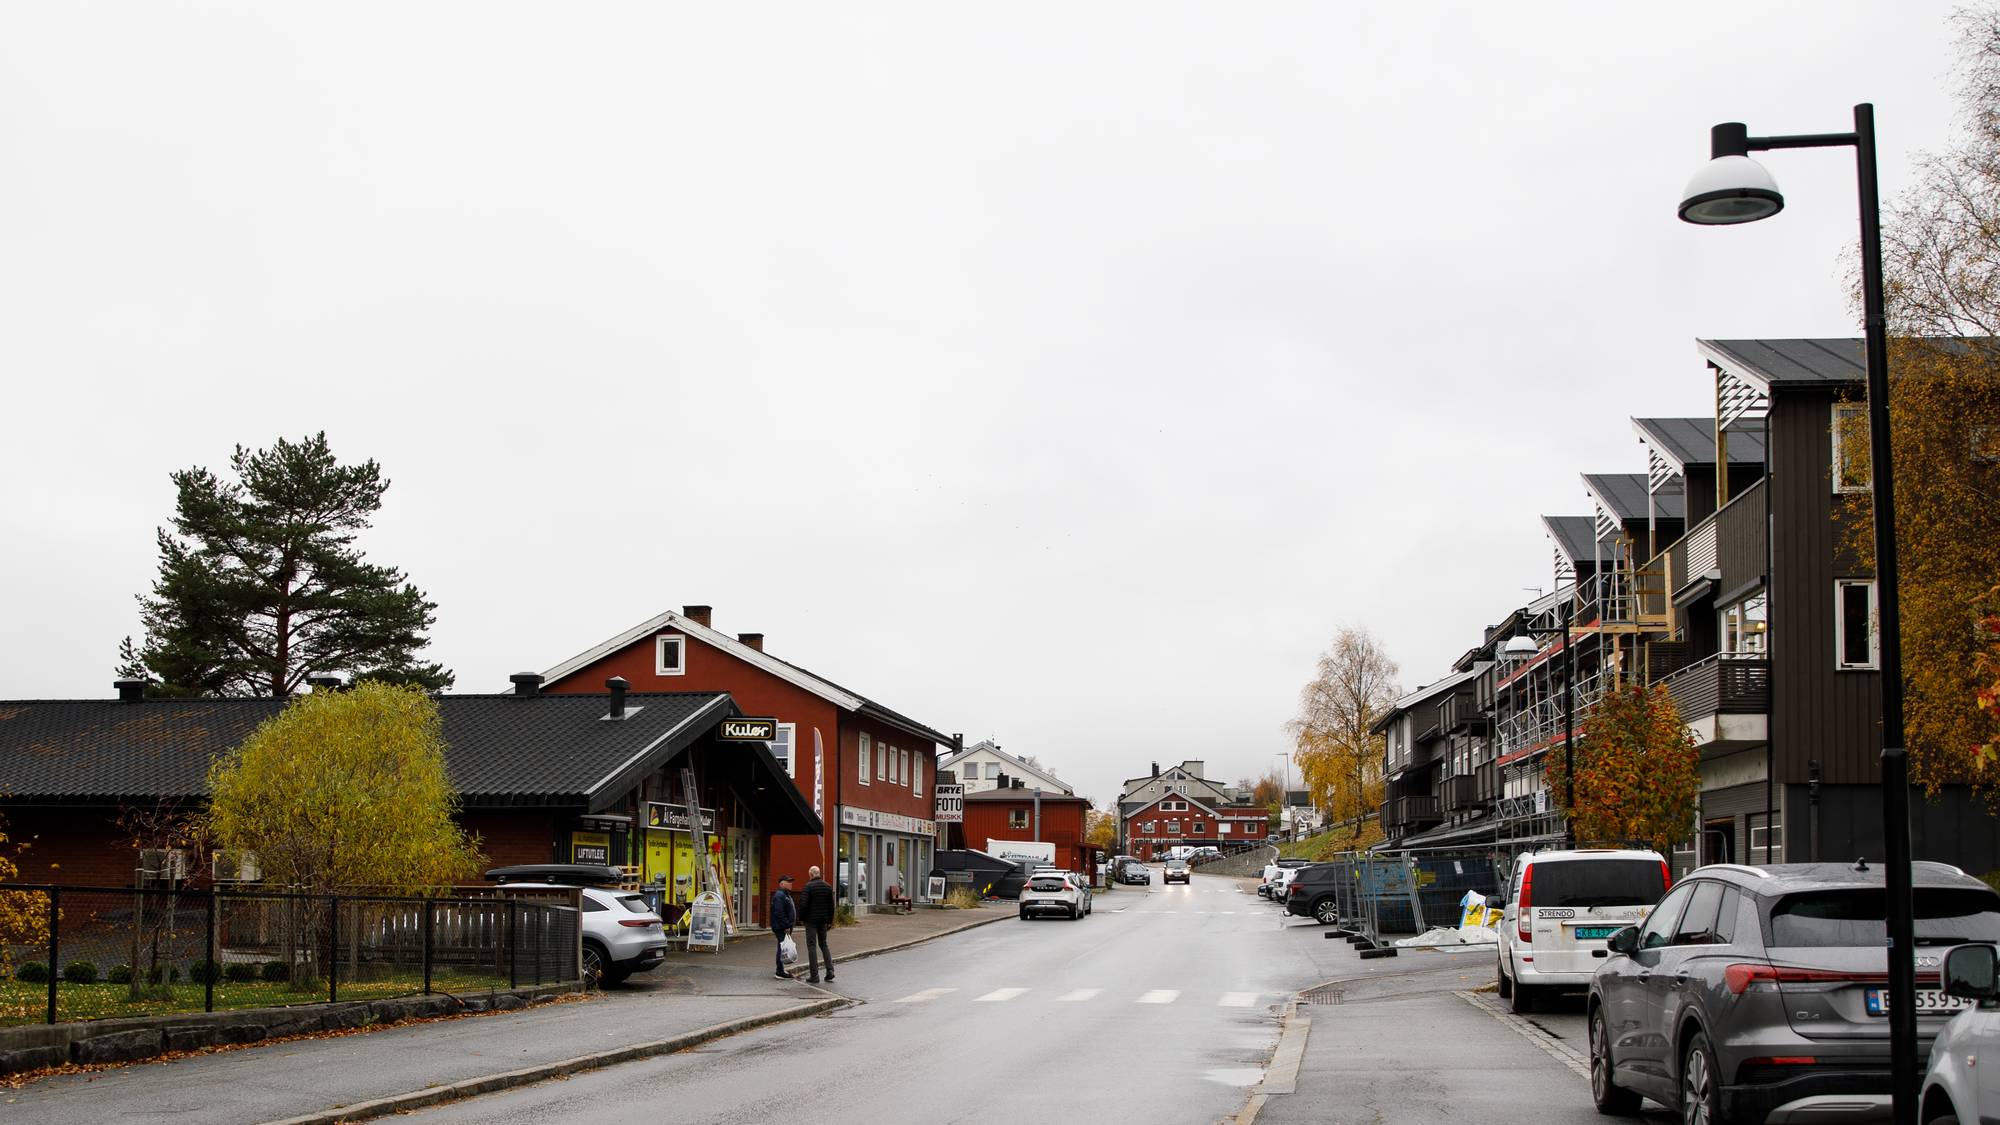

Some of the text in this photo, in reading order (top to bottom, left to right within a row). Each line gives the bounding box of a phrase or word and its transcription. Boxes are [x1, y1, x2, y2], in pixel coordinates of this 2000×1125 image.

[725, 723, 769, 736] Kulør
[937, 786, 962, 794] BRYE
[936, 797, 962, 812] FOTO
[669, 810, 690, 828] Fargeha
[936, 813, 962, 821] MUSIKK
[1916, 991, 1972, 1008] 55954
